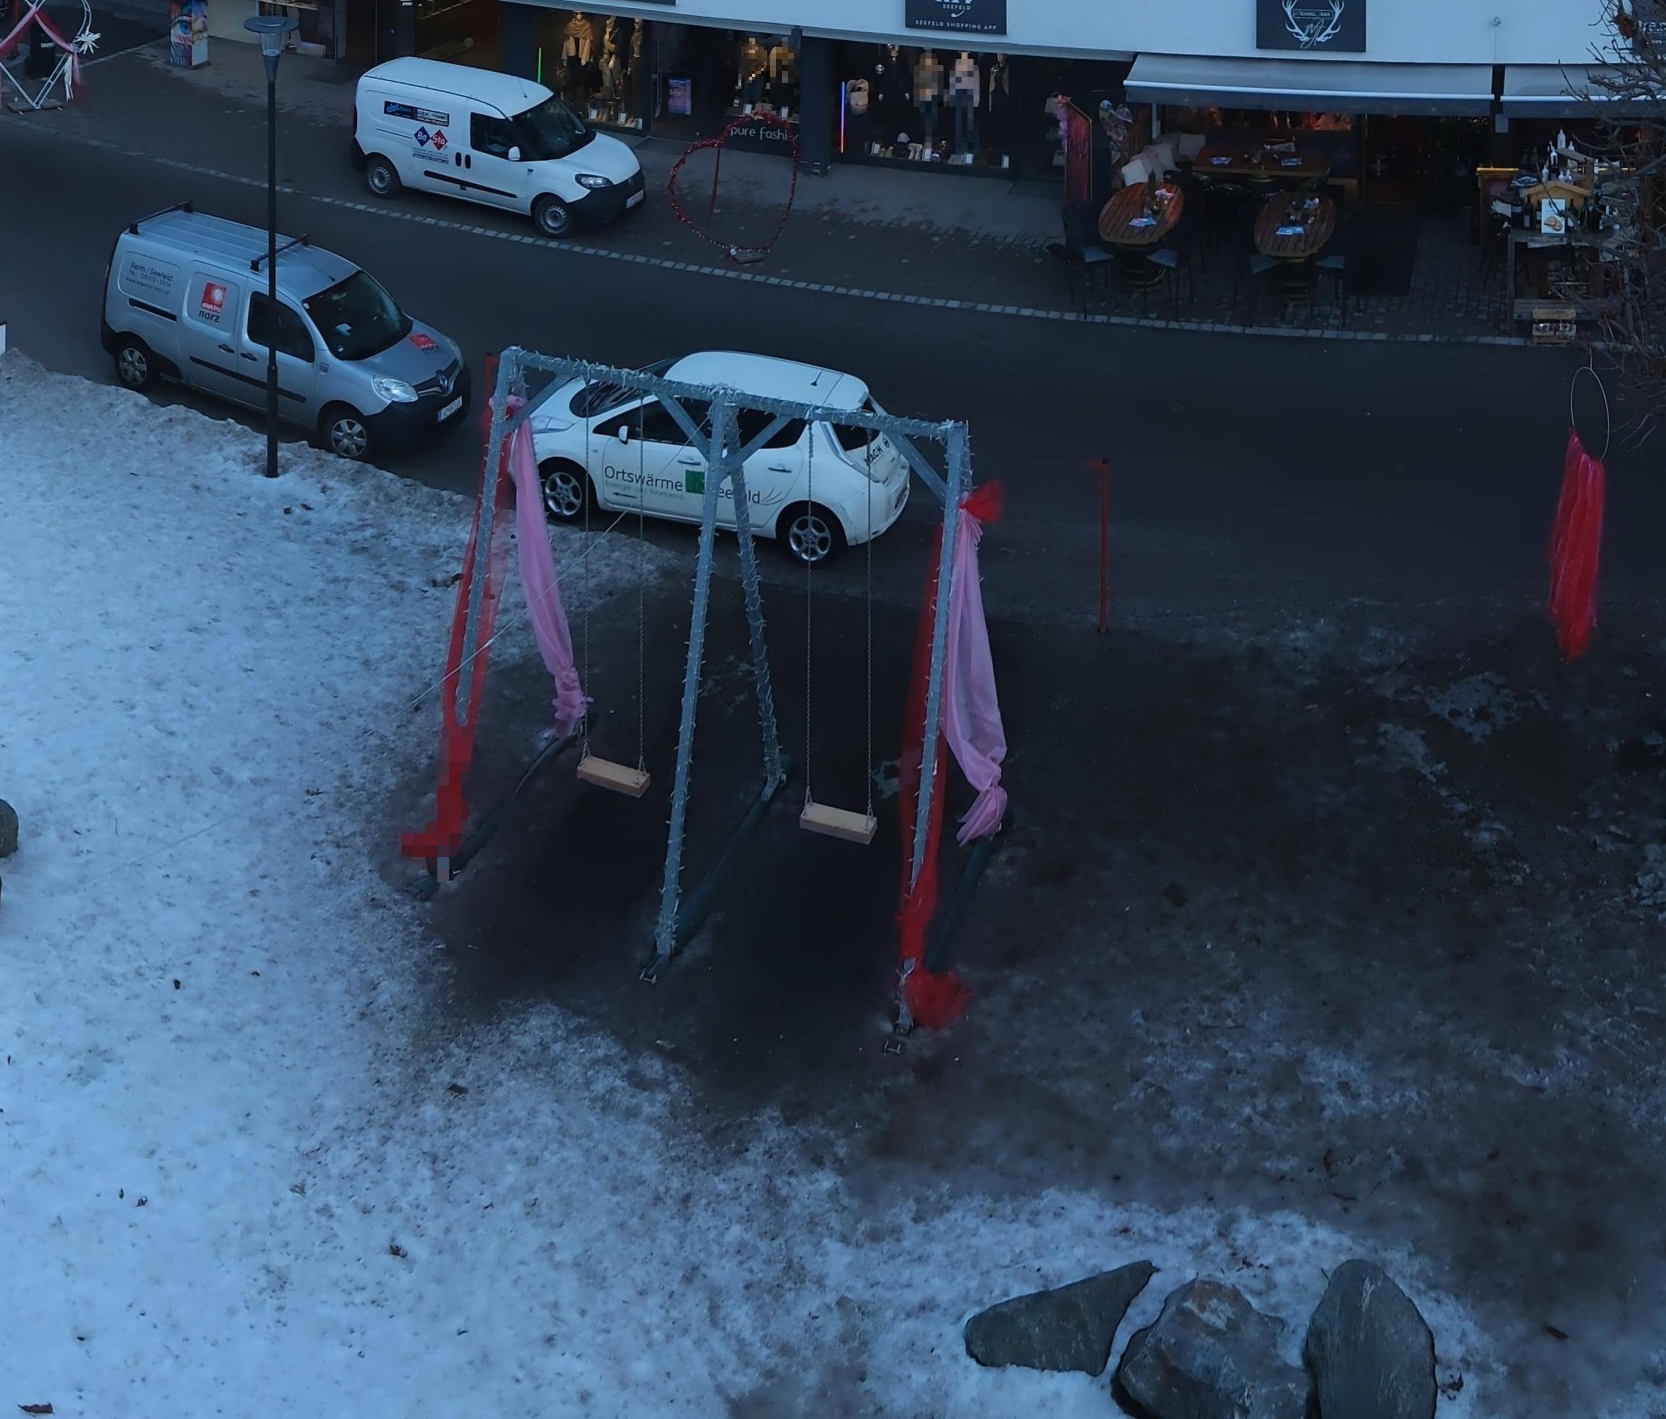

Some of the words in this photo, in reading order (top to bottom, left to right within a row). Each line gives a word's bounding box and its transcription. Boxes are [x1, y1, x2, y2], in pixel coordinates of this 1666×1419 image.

[942, 3, 972, 11] SEEFELD
[915, 19, 944, 28] SEEFELD
[946, 21, 982, 30] SHOPPING
[417, 130, 428, 142] Ba
[730, 126, 756, 138] pure
[199, 309, 221, 323] norz
[604, 465, 684, 492] Ortswärme
